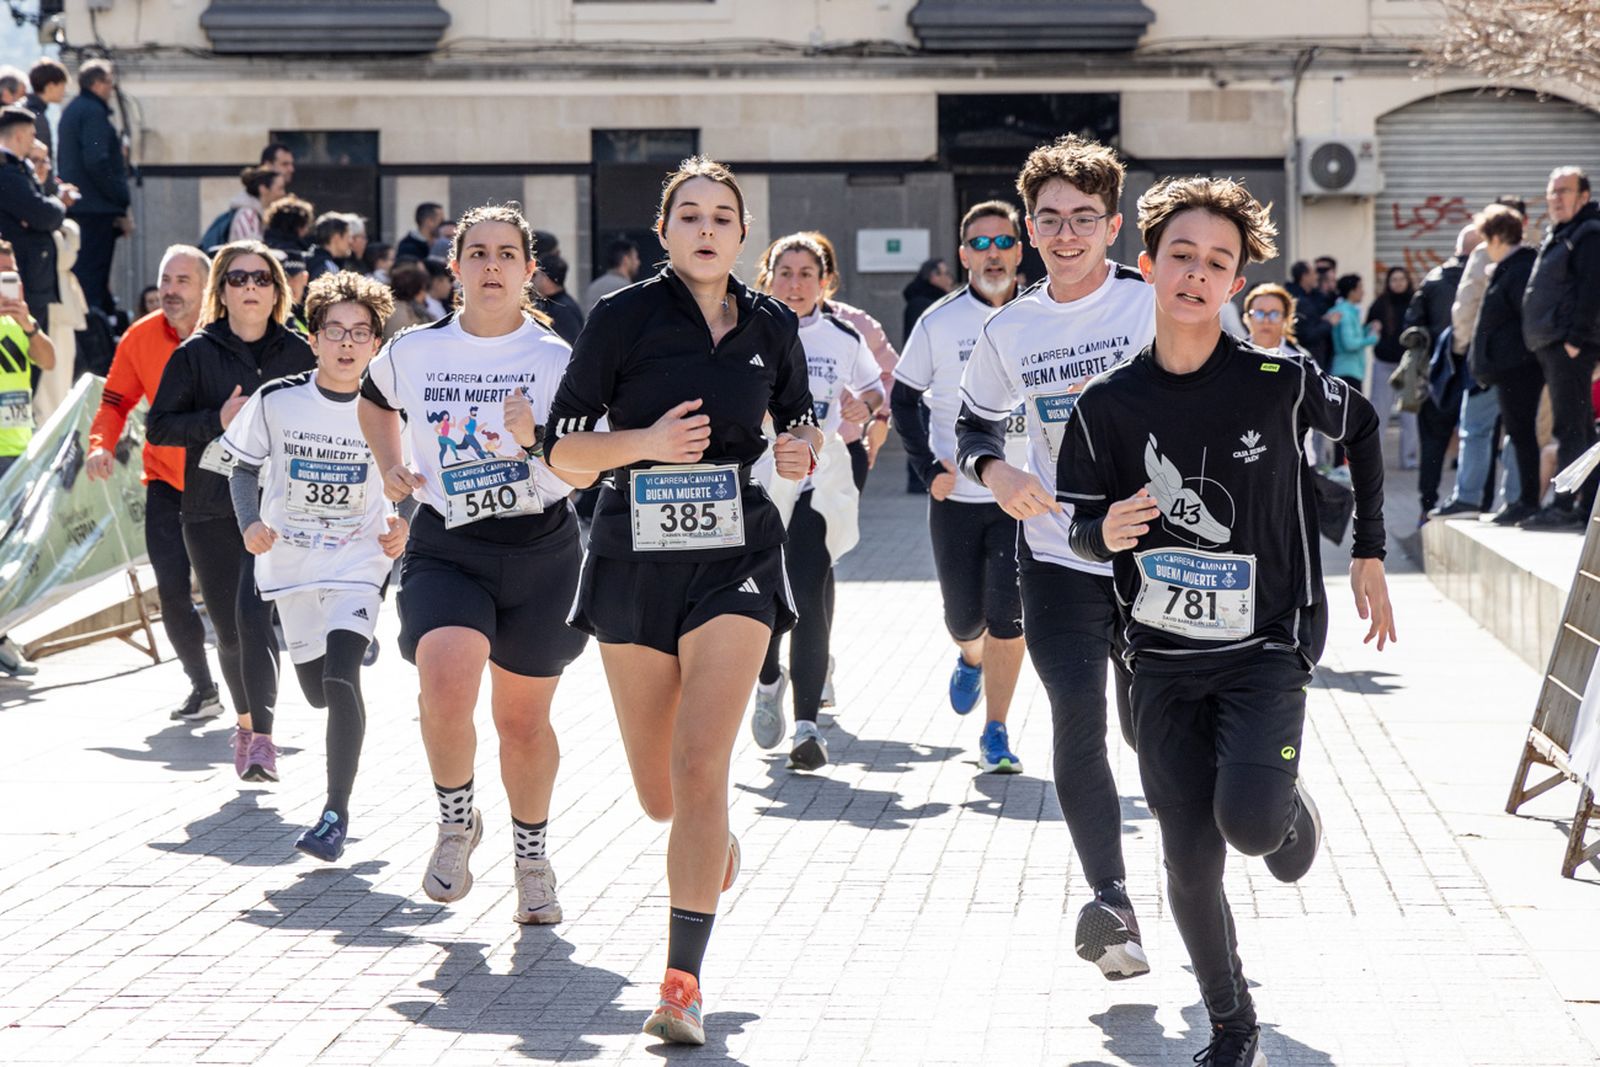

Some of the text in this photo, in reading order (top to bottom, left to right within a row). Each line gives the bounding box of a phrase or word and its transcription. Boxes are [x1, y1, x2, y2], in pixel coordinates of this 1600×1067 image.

[1030, 347, 1076, 364] CARRERA
[1078, 336, 1130, 355] CAMINATA
[426, 373, 536, 383] VI CARRERA CAMINATA
[1021, 356, 1109, 388] BUENA MUERTE
[424, 387, 461, 402] BUENA
[1046, 408, 1069, 419] BUENA
[292, 430, 333, 444] CARRERA
[336, 437, 369, 449] CAMINA
[283, 442, 313, 457] BUENA
[297, 469, 348, 483] BUENA MUERTE
[305, 462, 331, 471] CARRERA
[332, 464, 361, 472] CAMINATA
[458, 466, 485, 478] CARRERA
[486, 461, 519, 472] CAMINATA
[453, 471, 507, 492] BUENA MUERTE
[654, 477, 688, 485] CARRERA
[689, 473, 727, 484] CAMINATA
[305, 483, 349, 505] 382
[465, 485, 517, 518] 540
[646, 487, 711, 501] BUENA MUERTE
[660, 503, 717, 532] 385
[1170, 498, 1201, 525] 43
[1163, 555, 1195, 567] CARRERA
[1196, 561, 1238, 571] CAMINATA
[1156, 564, 1217, 587] BUENA MUERTE
[1163, 585, 1217, 621] 781
